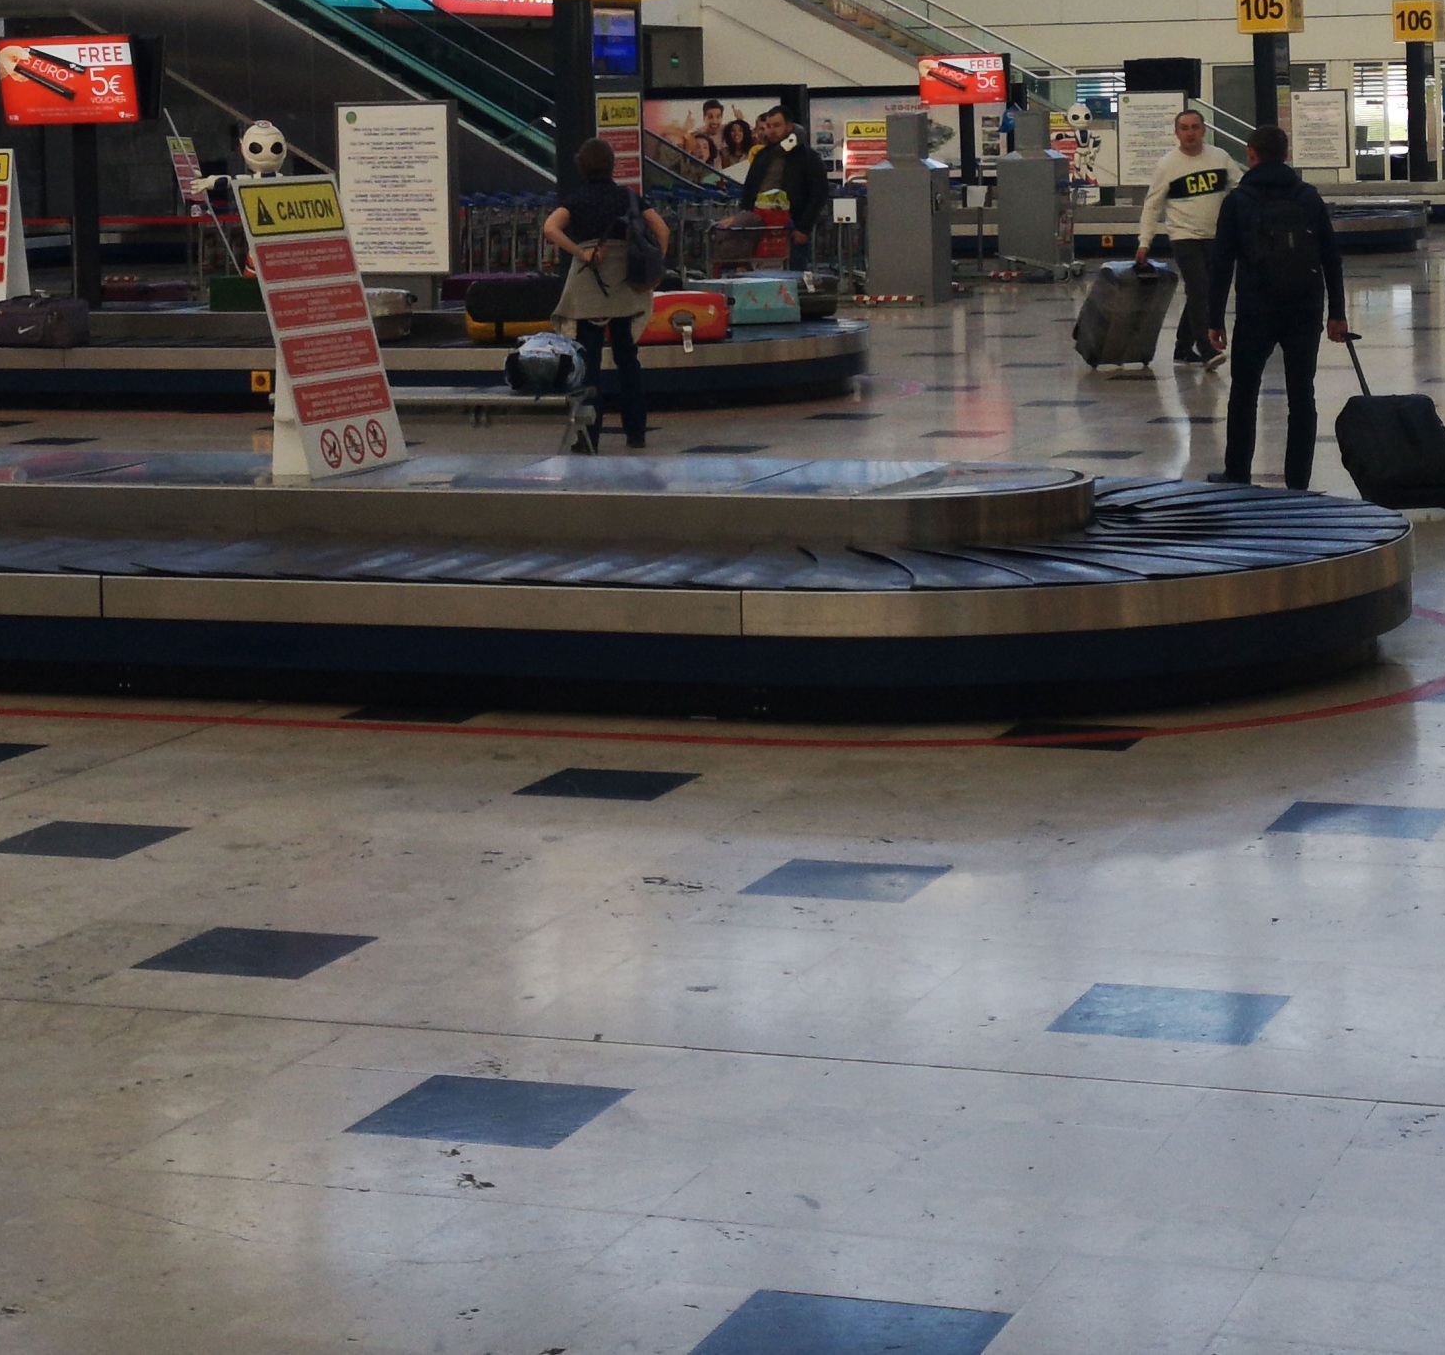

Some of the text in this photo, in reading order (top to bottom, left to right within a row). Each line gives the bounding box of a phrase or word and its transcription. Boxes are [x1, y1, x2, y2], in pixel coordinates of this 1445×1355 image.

[1396, 10, 1432, 31] 106
[77, 46, 124, 63] FREE
[969, 59, 1001, 70] FREE
[89, 67, 124, 96] 5€
[976, 72, 998, 88] 5€
[90, 96, 127, 104] VOUCHER
[865, 126, 885, 134] CAUT
[1185, 172, 1218, 194] GAP
[276, 198, 335, 221] CAUTION
